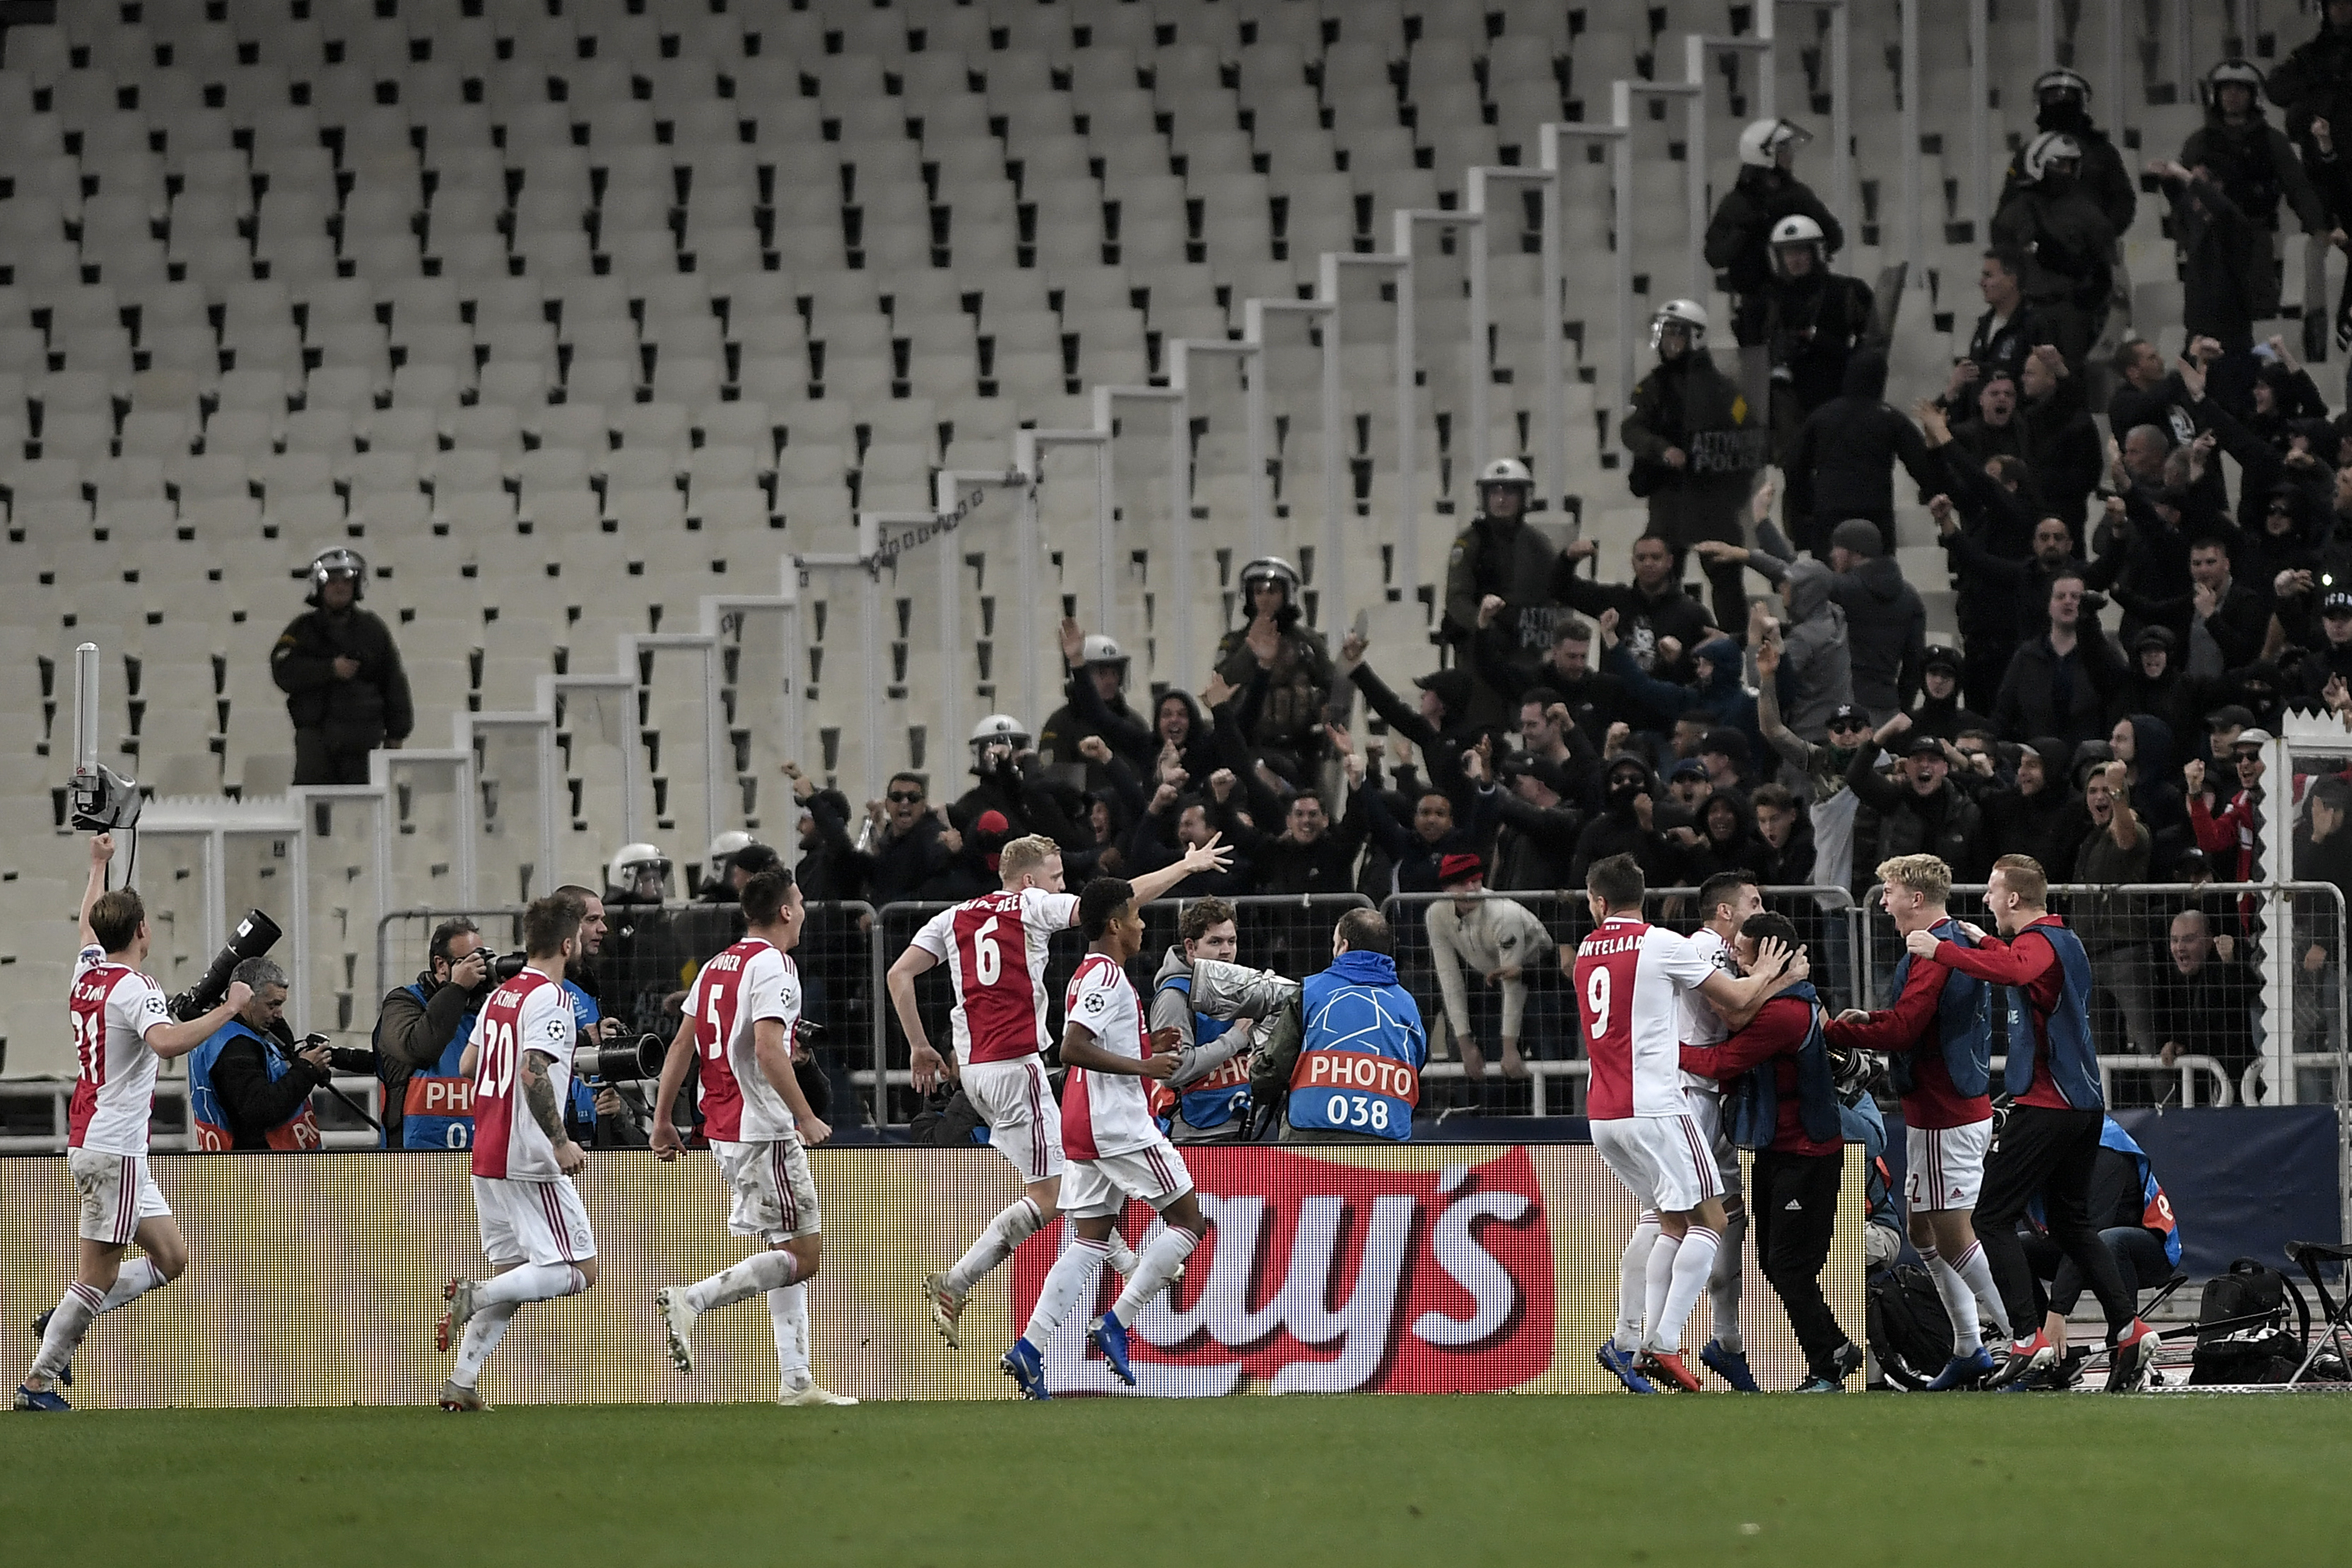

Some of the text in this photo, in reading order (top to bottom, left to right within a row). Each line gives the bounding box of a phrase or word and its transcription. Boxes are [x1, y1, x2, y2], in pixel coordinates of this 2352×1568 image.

[974, 915, 1001, 986] 6
[1579, 935, 1645, 957] UNTELAAR
[707, 984, 724, 1060] 5
[1588, 966, 1610, 1039] 9
[479, 1019, 513, 1099] 20
[1311, 1056, 1412, 1096] PHOTO
[426, 1082, 474, 1111] PH
[1327, 1095, 1388, 1130] 038
